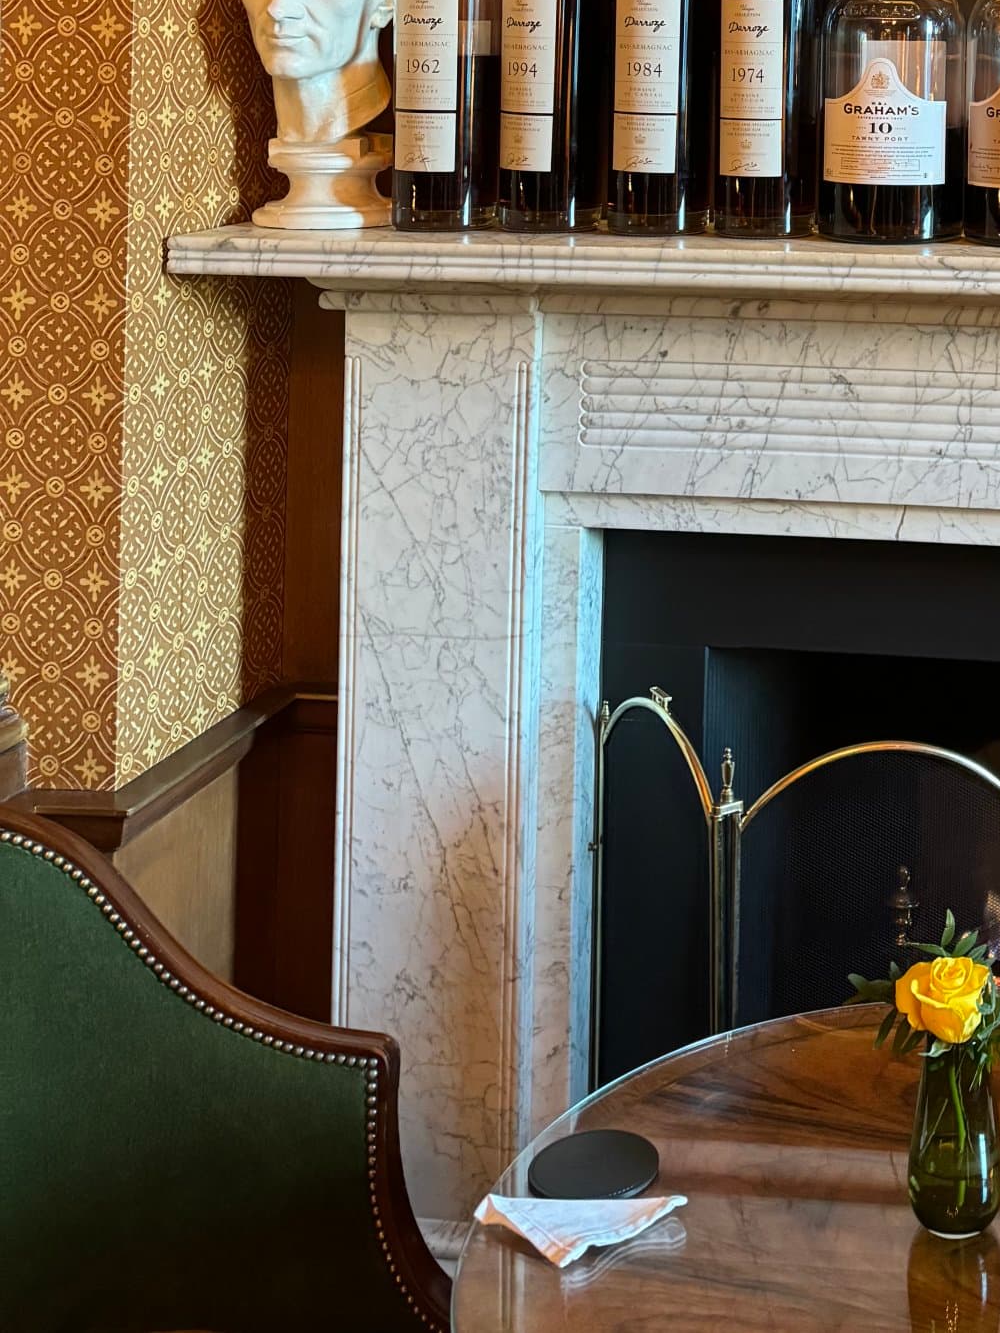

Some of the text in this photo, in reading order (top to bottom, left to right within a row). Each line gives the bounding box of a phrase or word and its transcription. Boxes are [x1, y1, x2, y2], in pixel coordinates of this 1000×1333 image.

[403, 14, 444, 30] Darroze
[506, 17, 542, 33] Darroze
[624, 16, 666, 32] Darroze
[728, 21, 770, 38] Darroze
[406, 58, 440, 74] 1962
[507, 62, 538, 78] 1994
[626, 62, 662, 78] 1984
[731, 68, 764, 83] 1974
[844, 102, 919, 116] GRAHAM'S
[868, 122, 893, 134] 10
